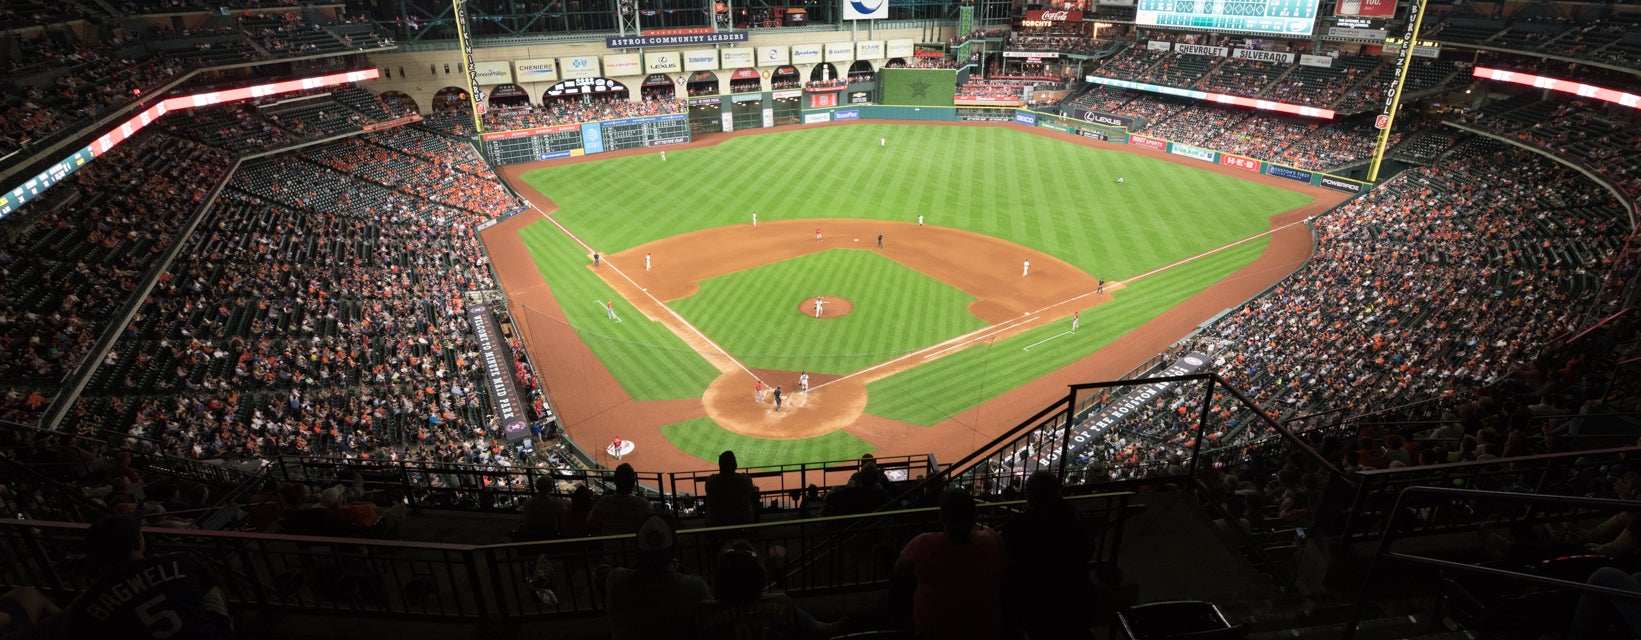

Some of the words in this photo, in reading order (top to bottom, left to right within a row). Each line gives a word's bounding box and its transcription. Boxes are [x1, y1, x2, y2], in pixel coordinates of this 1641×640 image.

[612, 38, 646, 46] ASTROS
[649, 35, 704, 44] COMMUNITY
[707, 33, 744, 41] LEADERS
[1179, 44, 1224, 56] CHEVROLET
[1240, 50, 1287, 62] SILVERADO
[519, 63, 553, 71] CHENIERE
[1394, 68, 1402, 77] R
[470, 71, 481, 102] FARE
[1383, 79, 1399, 114] FOUL
[1094, 116, 1122, 127] LEXUS
[1322, 178, 1360, 191] POWERADE
[474, 315, 489, 342] WELCOME
[481, 341, 492, 351] TO
[484, 350, 501, 377] MINUTE
[492, 377, 507, 397] MAID
[499, 399, 515, 419] PARK
[1074, 430, 1091, 443] OF
[1089, 416, 1114, 432] THE
[1111, 387, 1158, 418] HOUSTON
[86, 560, 187, 621] BAGWELL
[134, 593, 183, 640] 5
